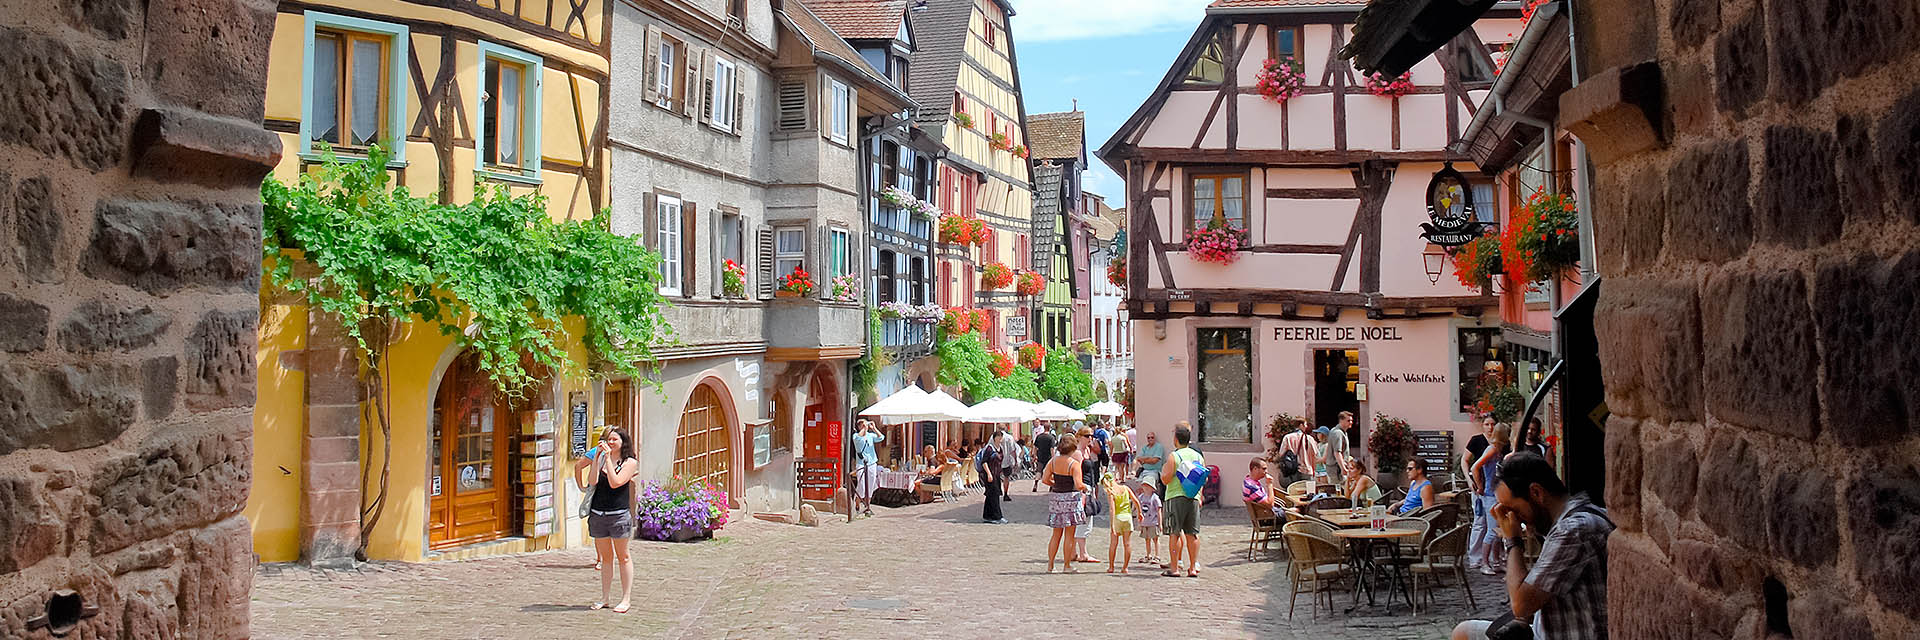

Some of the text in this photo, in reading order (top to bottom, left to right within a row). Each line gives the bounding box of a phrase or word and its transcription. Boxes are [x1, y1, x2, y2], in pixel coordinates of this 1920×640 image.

[1430, 234, 1472, 243] RESTAURANT
[1274, 327, 1402, 340] FEERIE DE NOEL
[1403, 372, 1446, 383] Wohlfahrt
